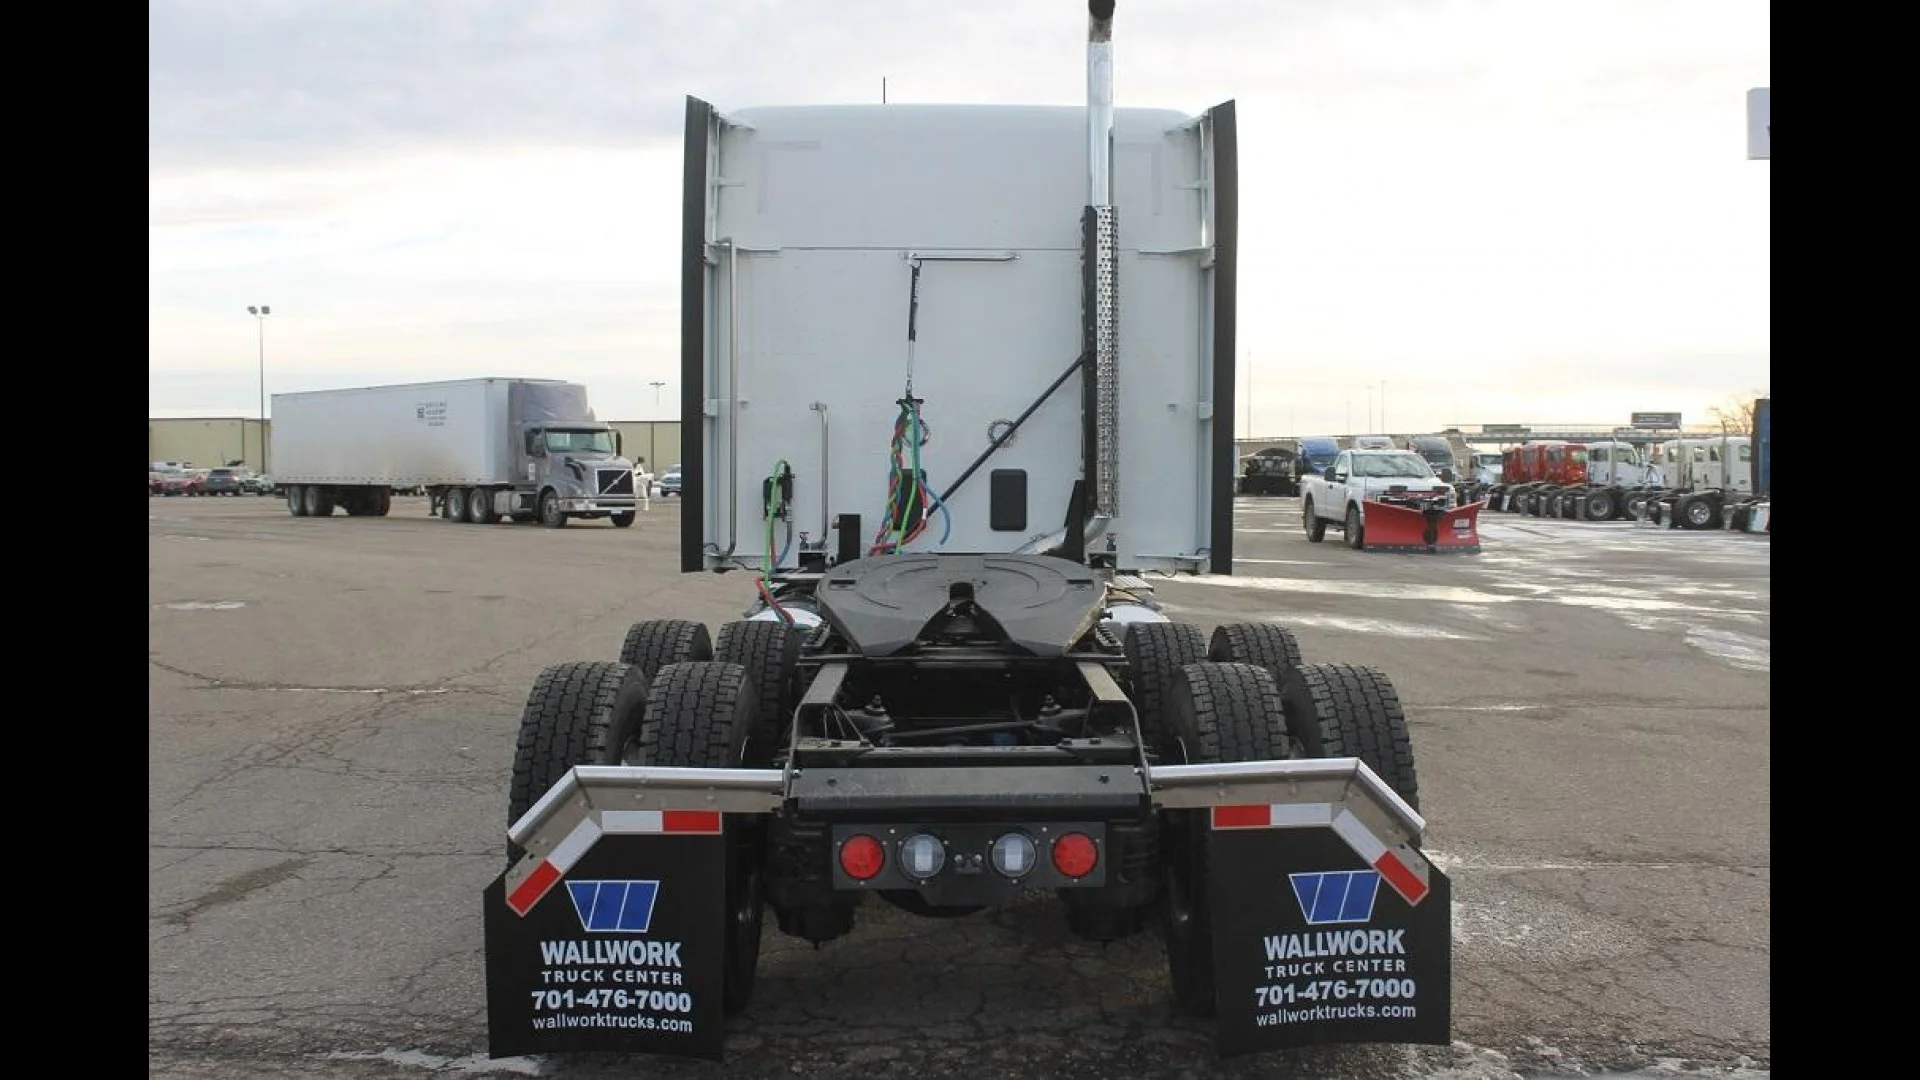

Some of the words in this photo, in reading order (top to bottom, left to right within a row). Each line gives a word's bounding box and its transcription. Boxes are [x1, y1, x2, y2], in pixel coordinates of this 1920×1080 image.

[540, 939, 682, 968] WALLWORK
[1263, 928, 1406, 961] WALLWORK
[541, 969, 604, 984] TRUCK
[612, 969, 683, 986] CENTER
[1264, 962, 1325, 979] TRUCK
[1332, 958, 1406, 974] CENTER
[531, 989, 692, 1013] 701-476-7000
[1254, 978, 1416, 1007] 701-476-7000
[532, 1012, 693, 1033] wallworktrucks.com
[1256, 1002, 1416, 1027] wallworktrucks.com
